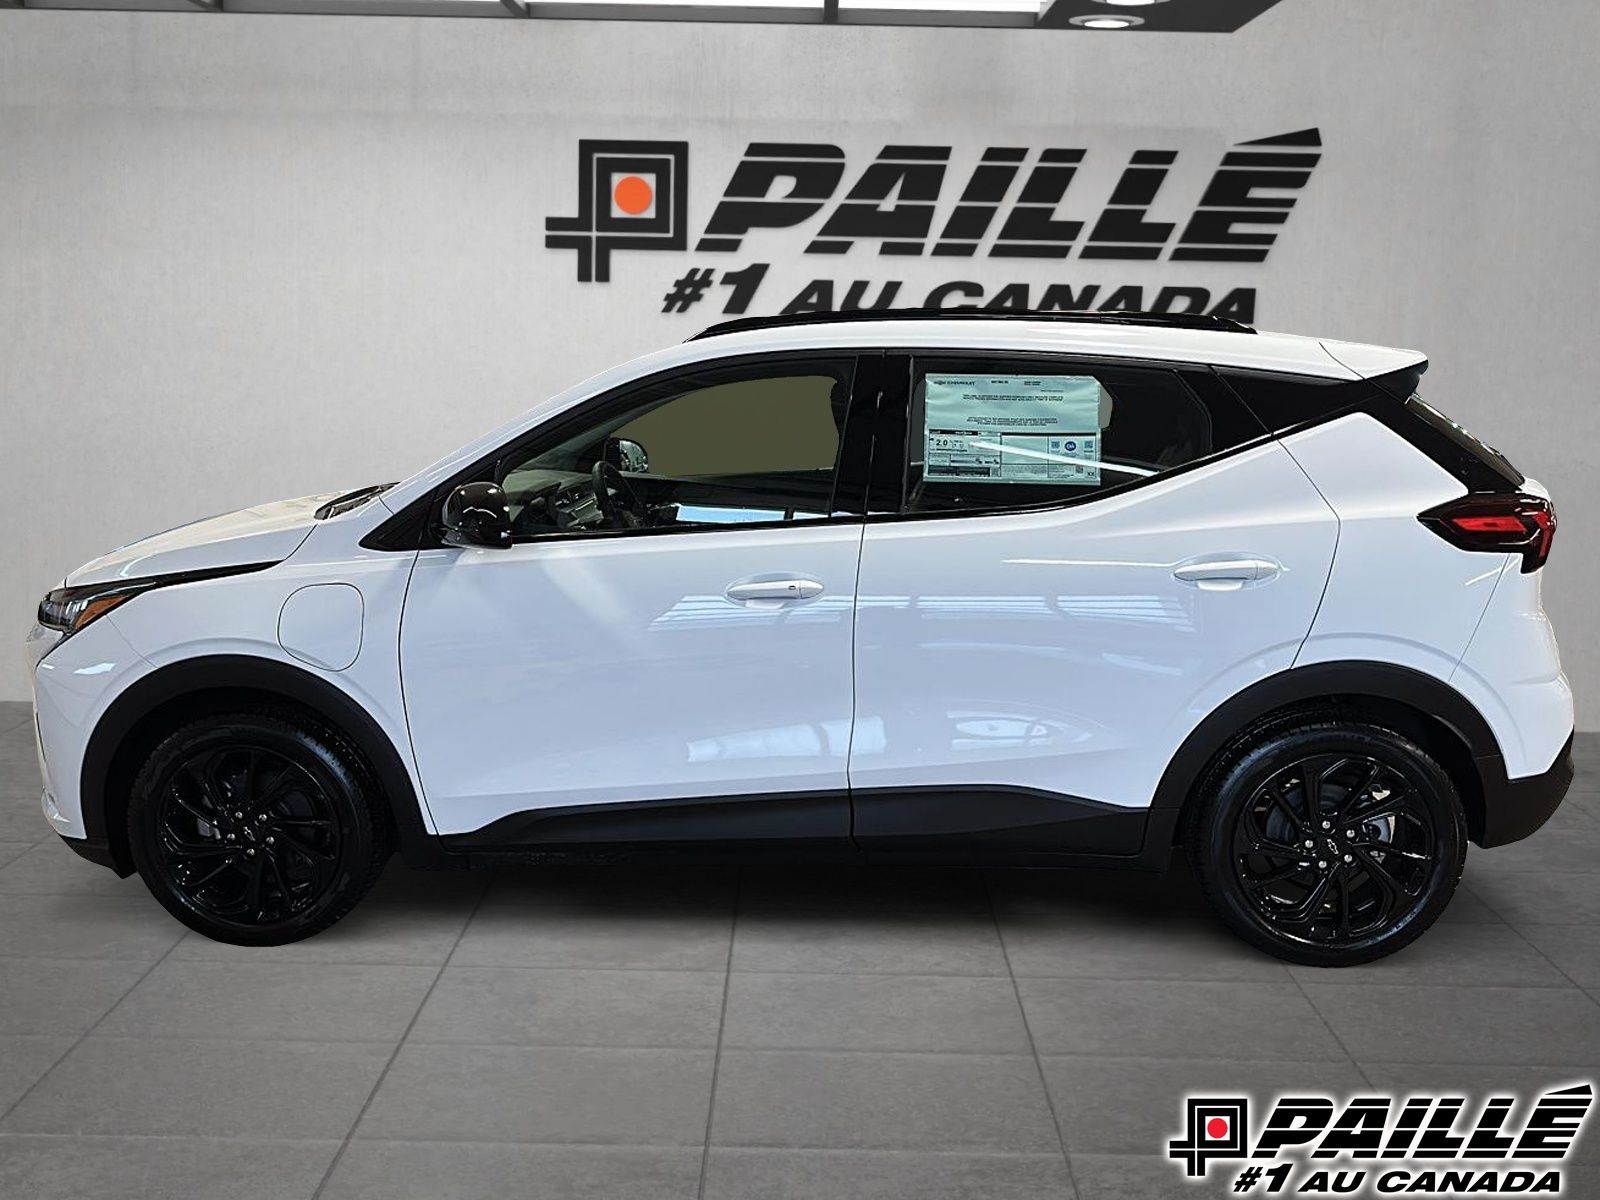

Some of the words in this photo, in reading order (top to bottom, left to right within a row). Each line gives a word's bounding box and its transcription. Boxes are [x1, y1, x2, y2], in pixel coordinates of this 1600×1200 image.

[694, 127, 1323, 263] PAILLÉ
[661, 263, 770, 314] #1
[783, 279, 903, 313] AU
[920, 281, 1256, 324] CANADA
